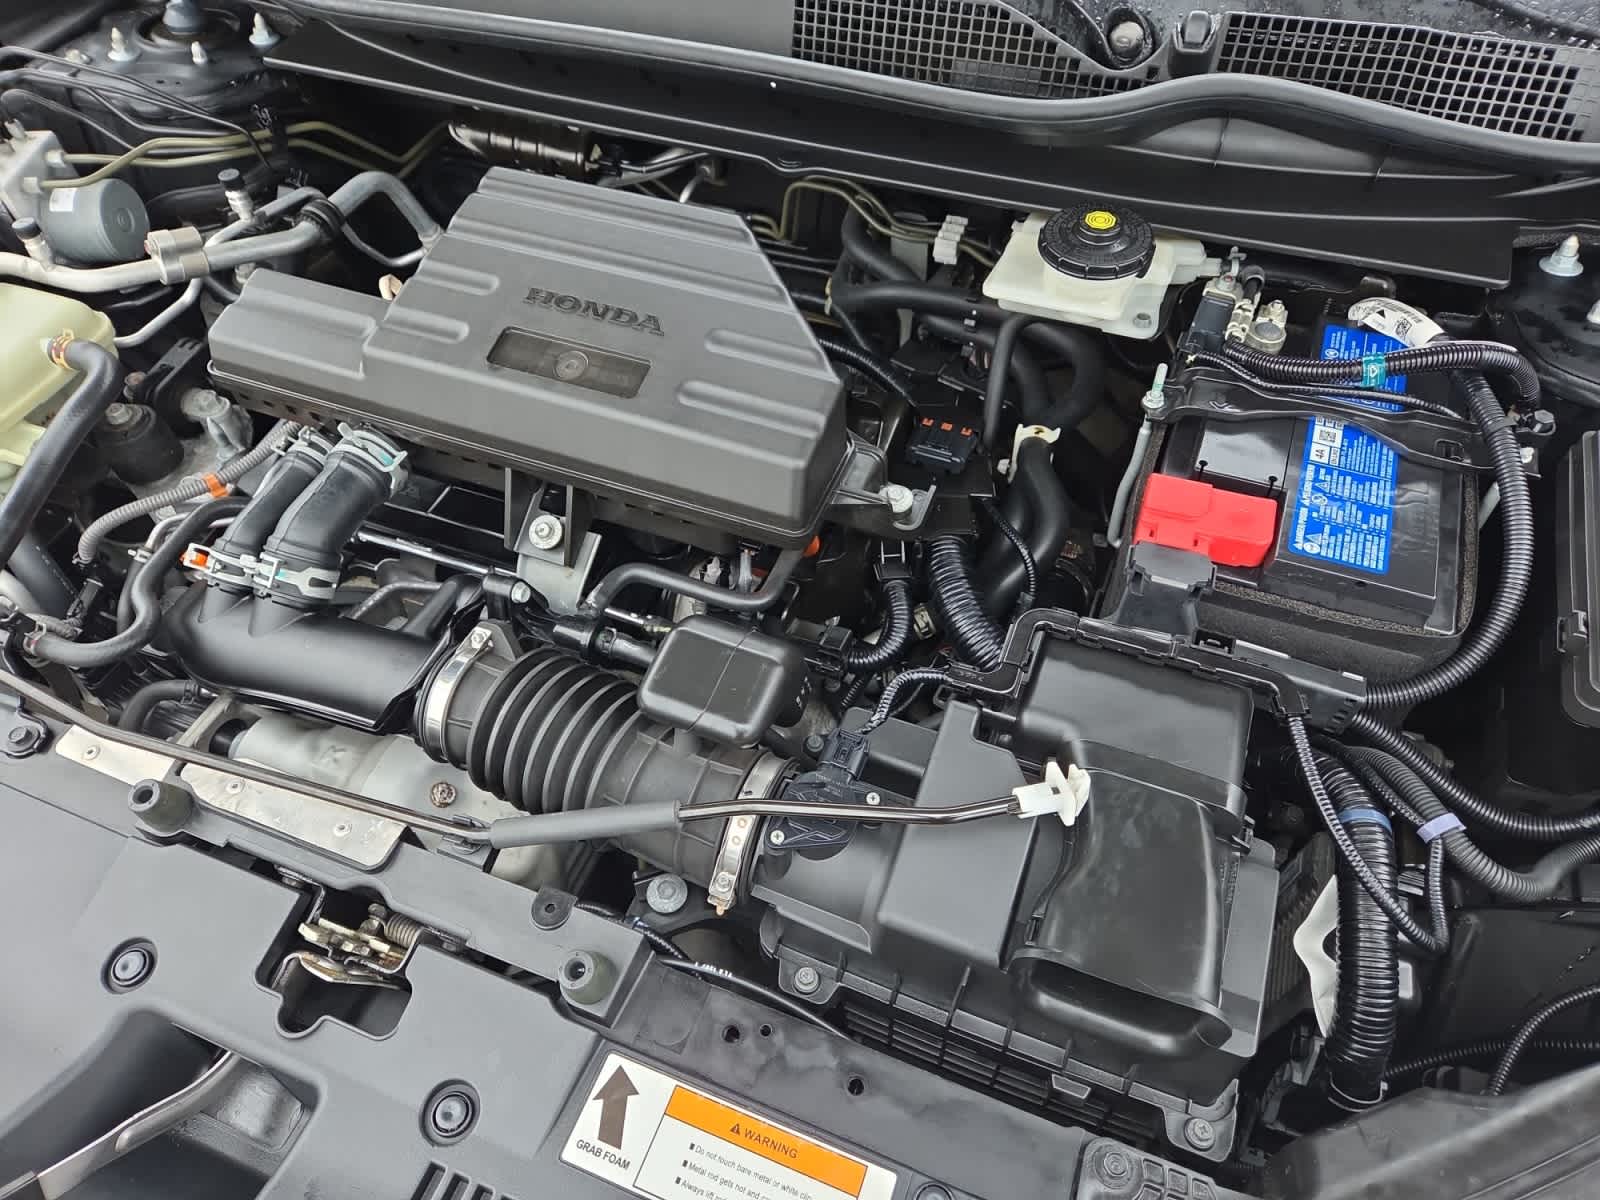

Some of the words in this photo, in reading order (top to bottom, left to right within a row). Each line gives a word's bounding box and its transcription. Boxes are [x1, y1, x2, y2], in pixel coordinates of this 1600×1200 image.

[523, 287, 665, 337] HONDA
[576, 1139, 602, 1157] GRAB
[603, 1151, 631, 1170] FOAM
[743, 1128, 798, 1158] WARNING
[688, 1162, 707, 1176] Metal
[719, 1176, 734, 1189] gets
[695, 1144, 705, 1155] Do
[705, 1151, 717, 1160] not
[754, 1171, 772, 1185] metal
[681, 1179, 705, 1197] Always
